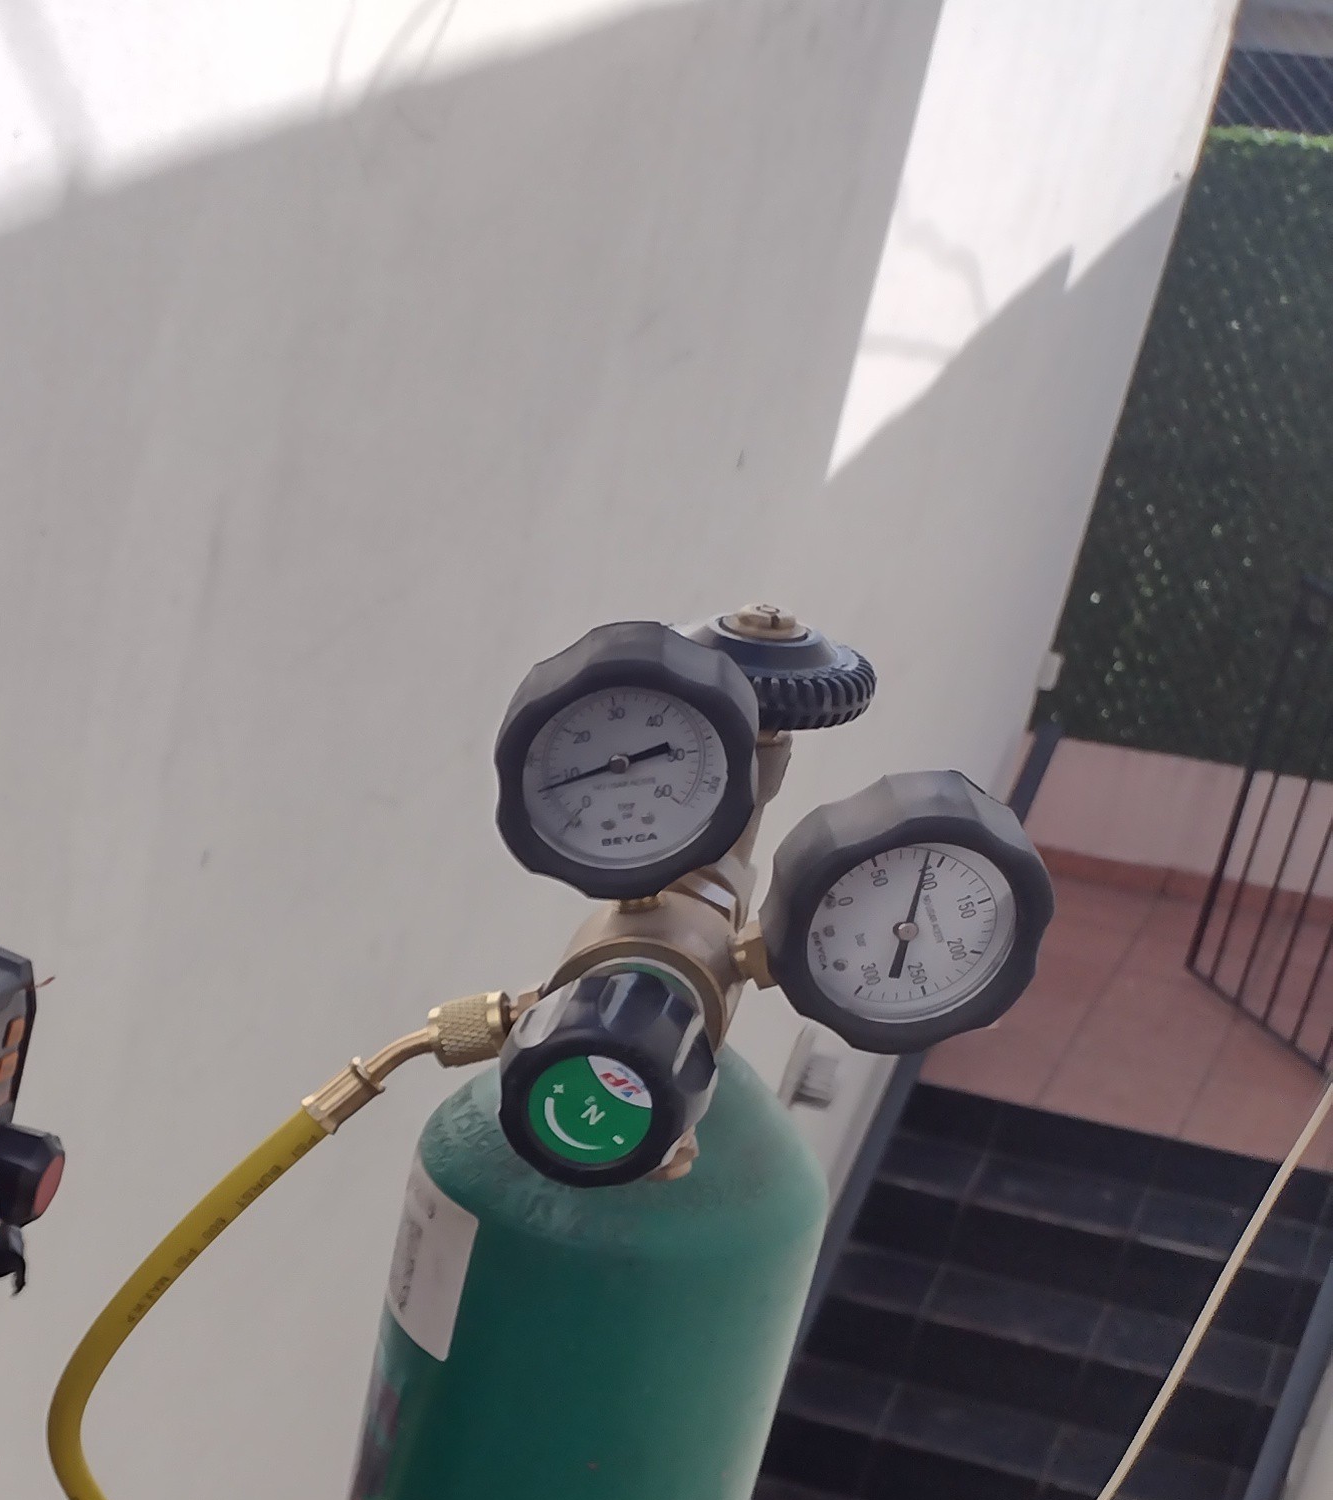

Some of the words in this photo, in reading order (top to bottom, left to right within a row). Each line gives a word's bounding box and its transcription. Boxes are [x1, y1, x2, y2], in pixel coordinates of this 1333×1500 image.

[607, 706, 625, 721] 30
[646, 714, 663, 727] 40
[573, 730, 591, 744] 20
[654, 784, 672, 798] 60
[870, 868, 889, 887] 50
[838, 896, 854, 907] 0
[956, 894, 976, 919] 150
[946, 937, 967, 961] 200
[861, 962, 881, 986] 300
[907, 962, 928, 985] 250
